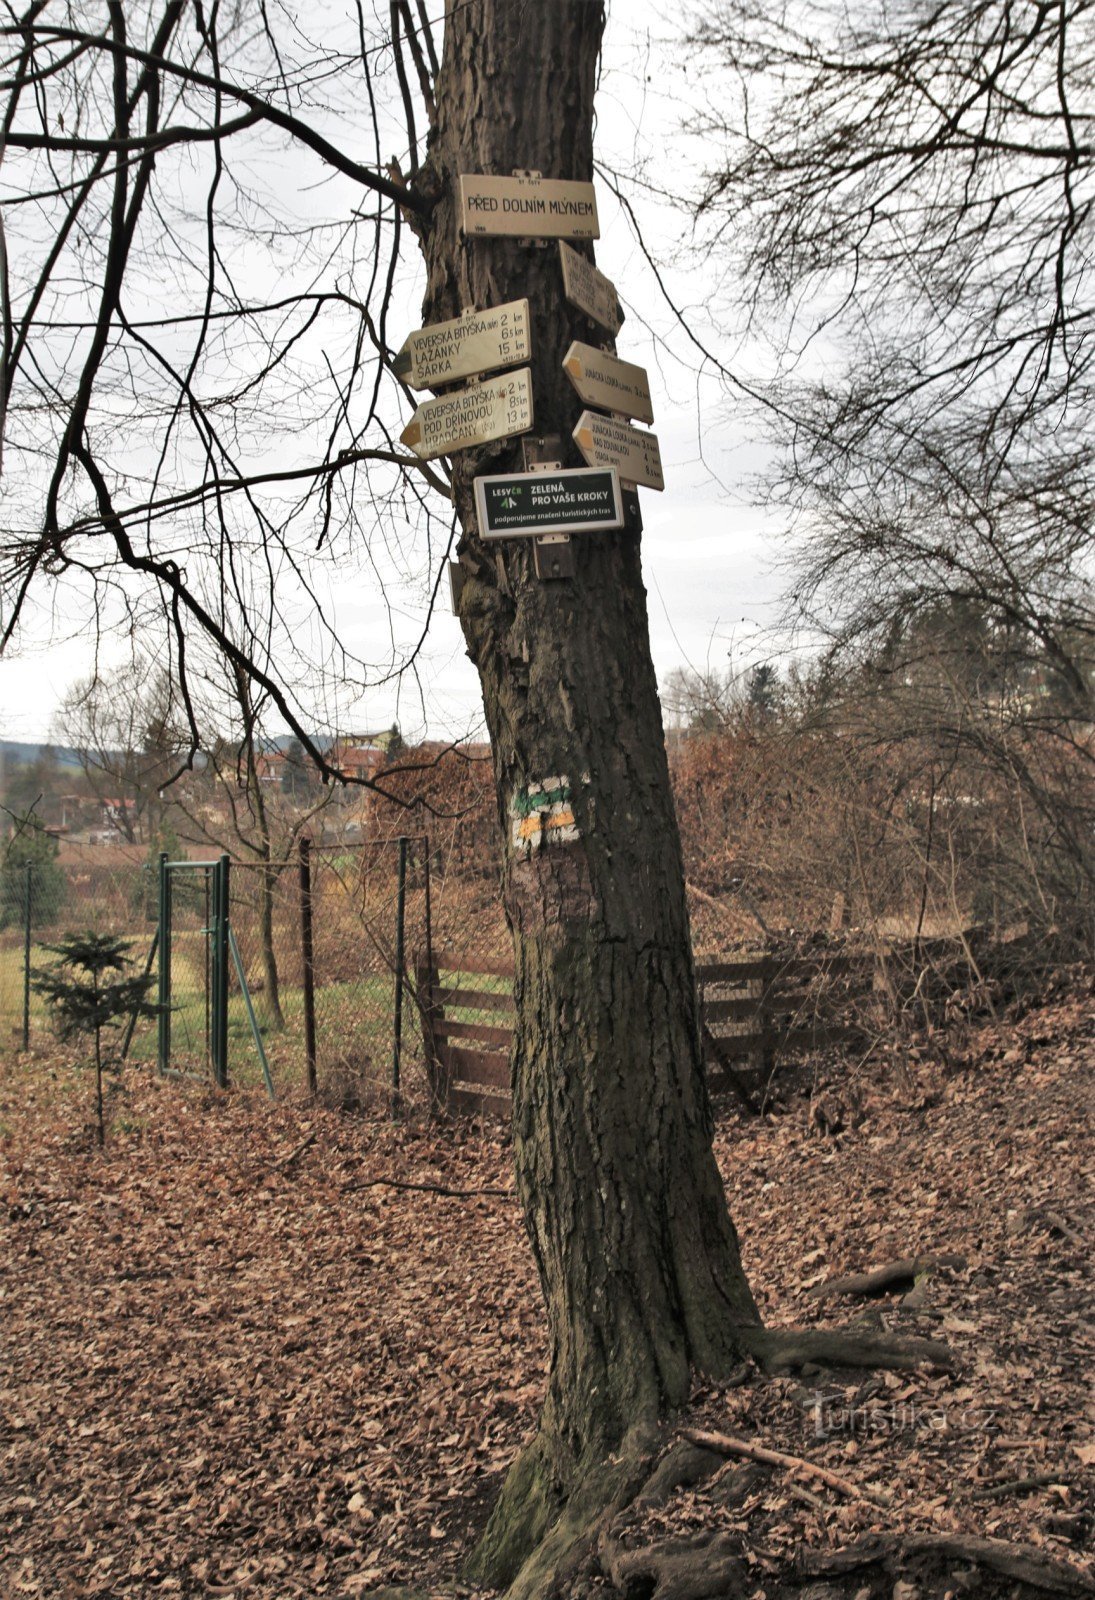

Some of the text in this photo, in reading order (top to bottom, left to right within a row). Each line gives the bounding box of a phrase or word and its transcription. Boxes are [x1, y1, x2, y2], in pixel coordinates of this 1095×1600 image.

[468, 194, 593, 216] PŘED DOLNÍM MLÝNEM
[414, 328, 453, 350] VEVERSKÁ
[501, 314, 508, 326] 2
[514, 313, 522, 322] km
[416, 342, 460, 364] LAŽÁNKY
[515, 327, 523, 336] km
[418, 341, 524, 378] ŠÁRKA 15 km
[423, 398, 461, 421] VEVERSKÁ
[508, 383, 515, 394] 2
[519, 382, 526, 391] km
[424, 421, 441, 435] POD
[425, 424, 476, 449] HRADČANY
[507, 411, 517, 424] 13
[521, 409, 528, 418] km
[531, 482, 564, 494] ZELENÁ
[532, 491, 608, 506] PRO VAŠE KROKY
[494, 514, 536, 524] podporujeme
[537, 511, 561, 520] značení
[562, 508, 597, 518] turistických
